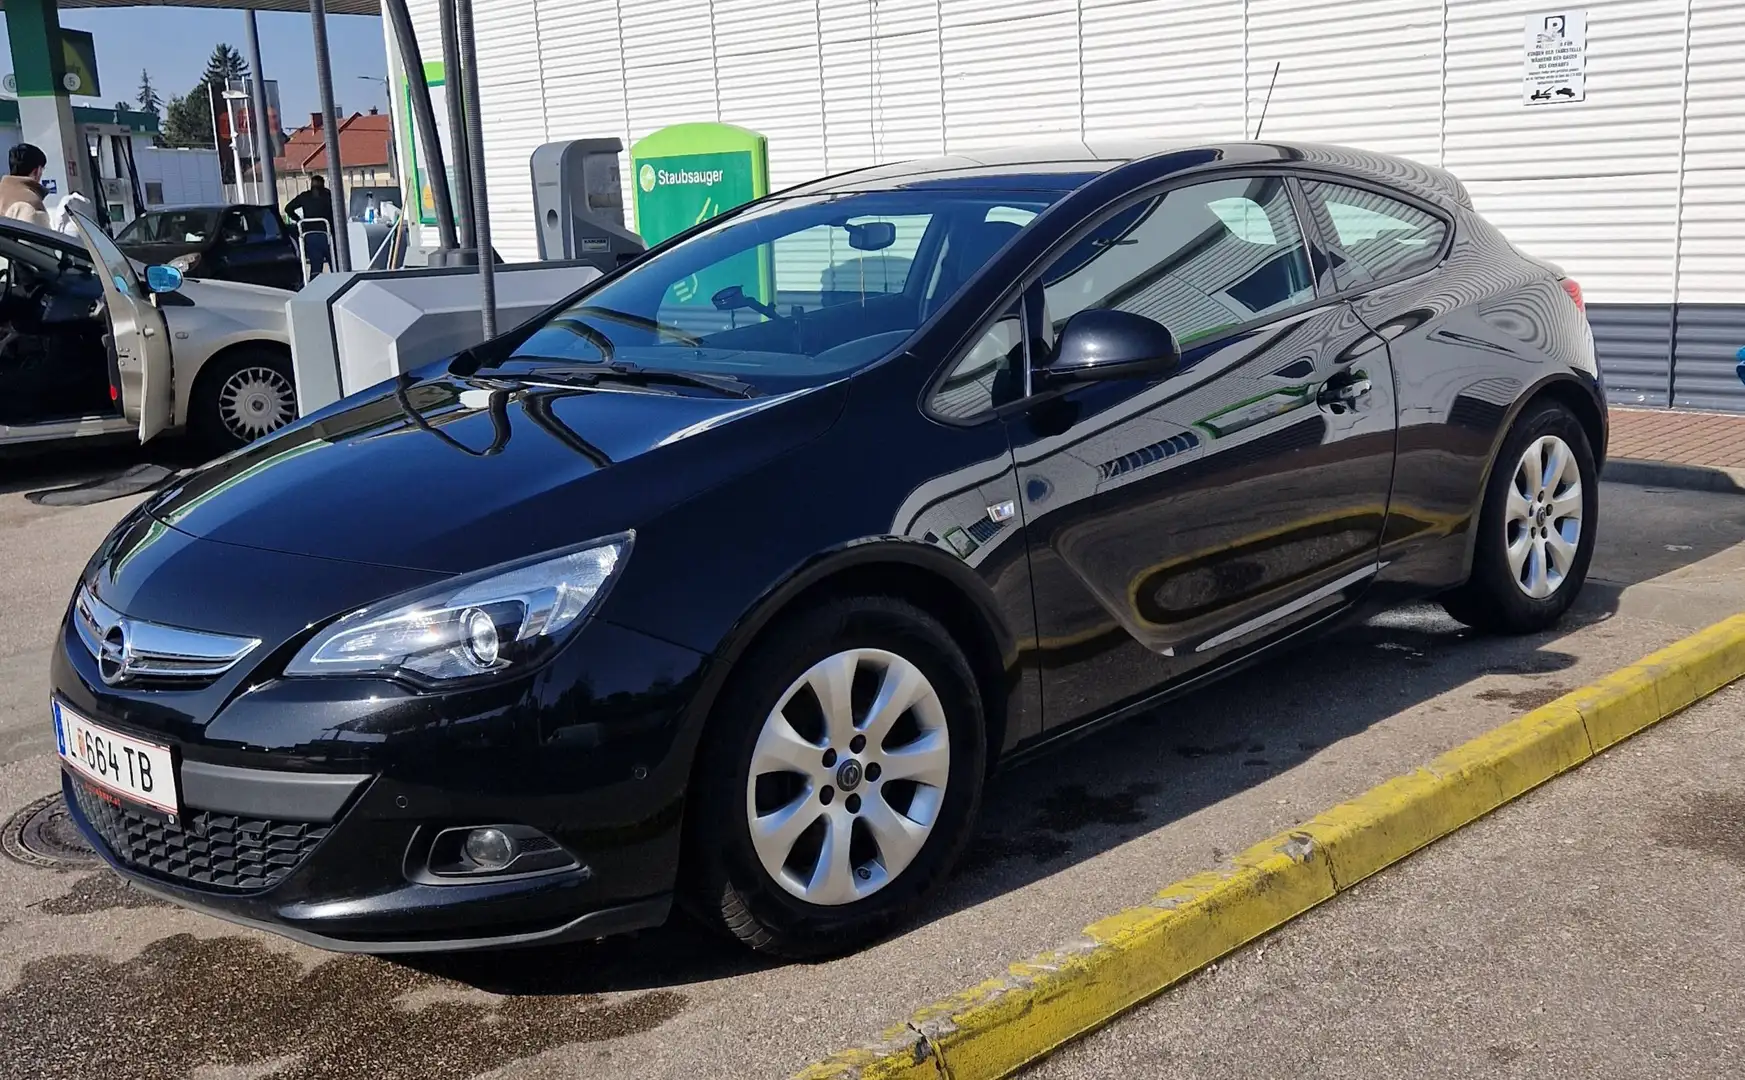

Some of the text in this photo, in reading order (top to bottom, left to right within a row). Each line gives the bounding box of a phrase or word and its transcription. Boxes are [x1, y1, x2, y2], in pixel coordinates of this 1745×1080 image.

[658, 169, 723, 187] Staubsauger
[66, 718, 154, 793] L 664 TB
